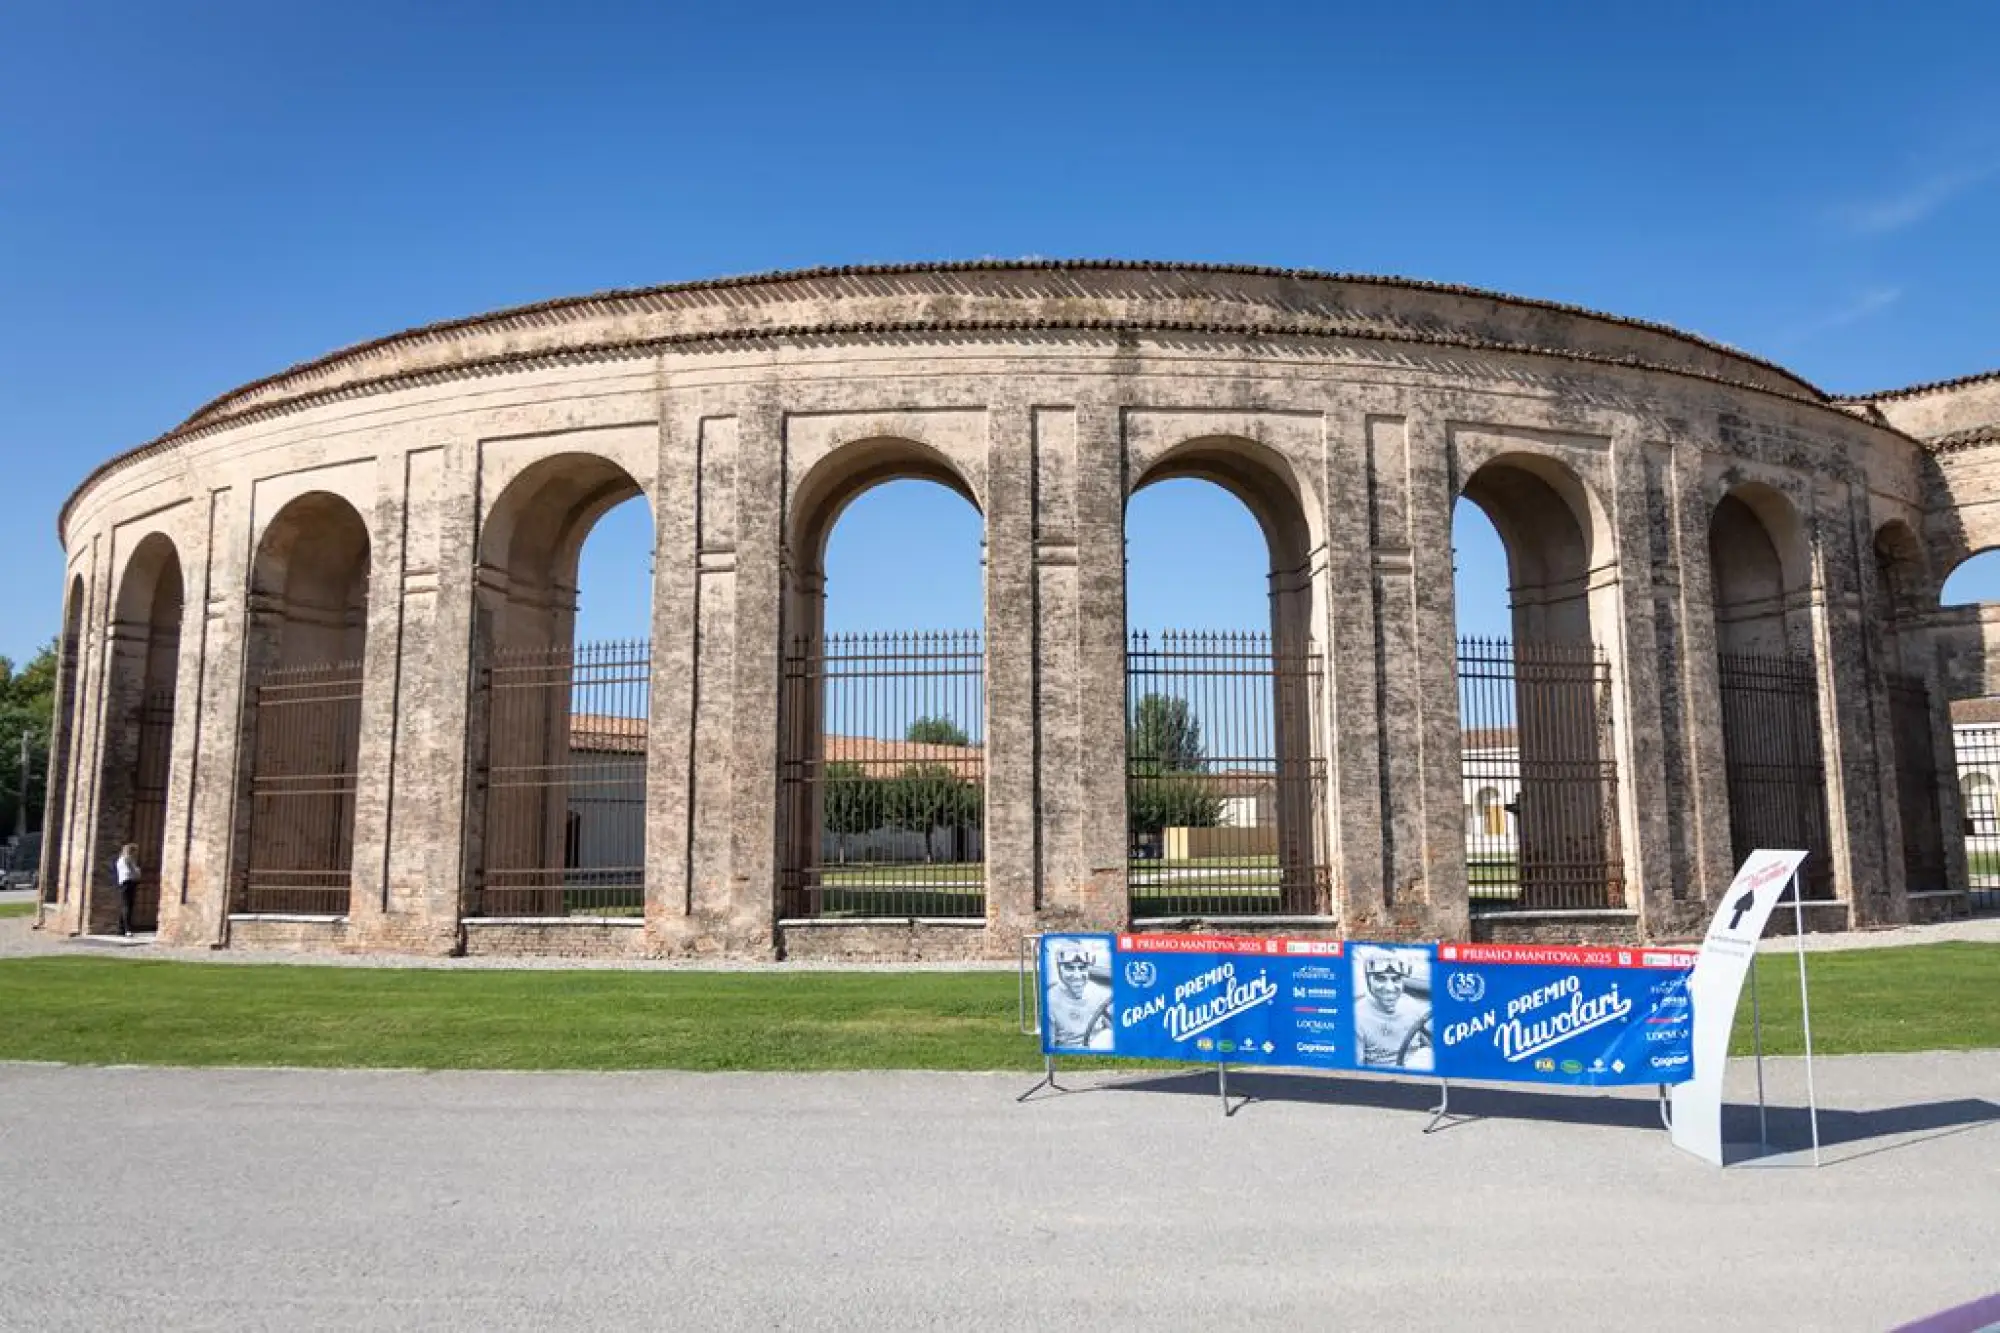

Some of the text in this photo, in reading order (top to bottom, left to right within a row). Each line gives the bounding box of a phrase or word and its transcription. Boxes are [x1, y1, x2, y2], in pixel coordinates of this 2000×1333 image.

[1137, 938, 1178, 949] PREMIO
[1181, 940, 1235, 951] MANTOVA
[1462, 949, 1612, 964] PREMIO MANTOVA 2025
[1122, 962, 1235, 1027] GRAN PREMIO
[1164, 968, 1278, 1042] Nuvolari
[1443, 975, 1580, 1045] GRAN PREMIO
[1457, 973, 1475, 988] 35
[1493, 983, 1631, 1062] Nuvolari
